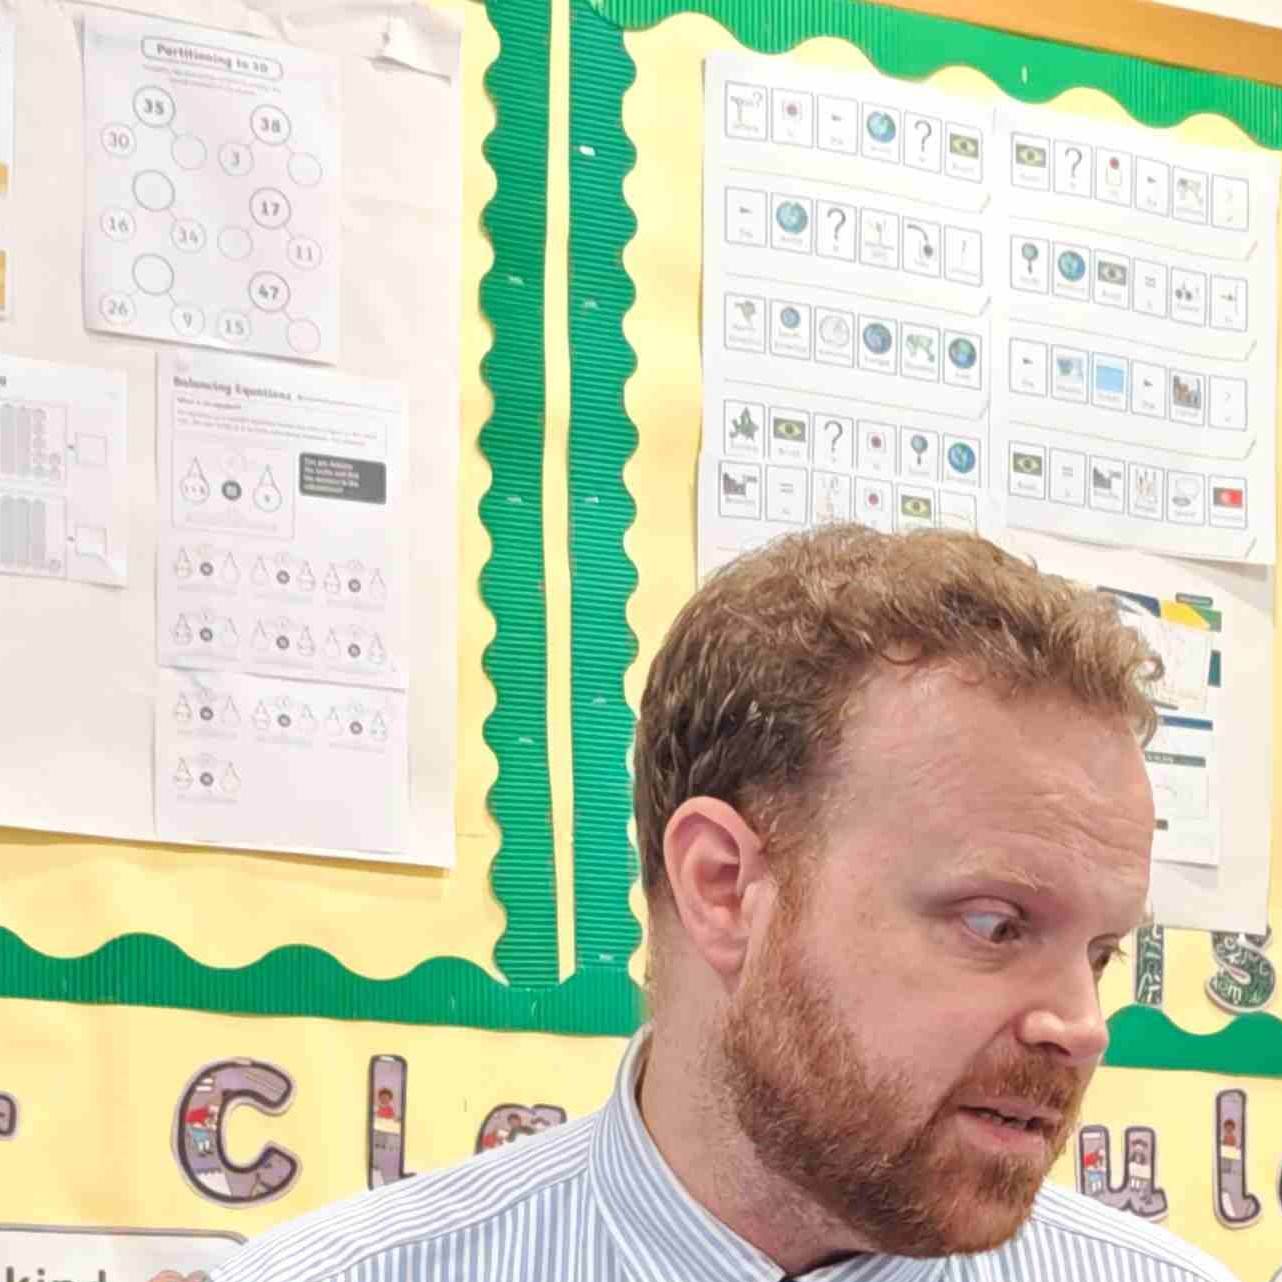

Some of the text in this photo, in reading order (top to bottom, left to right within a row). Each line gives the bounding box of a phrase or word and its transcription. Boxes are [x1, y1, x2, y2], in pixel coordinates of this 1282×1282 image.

[156, 43, 232, 69] Partitioning
[143, 98, 165, 116] 35
[260, 117, 281, 134] 38
[108, 131, 130, 149] 30
[261, 201, 280, 217] 17
[109, 216, 129, 232] 16
[296, 245, 313, 262] 11
[258, 284, 279, 300] 47
[108, 299, 129, 316] 26
[183, 311, 192, 328] 9
[225, 318, 244, 335] 15
